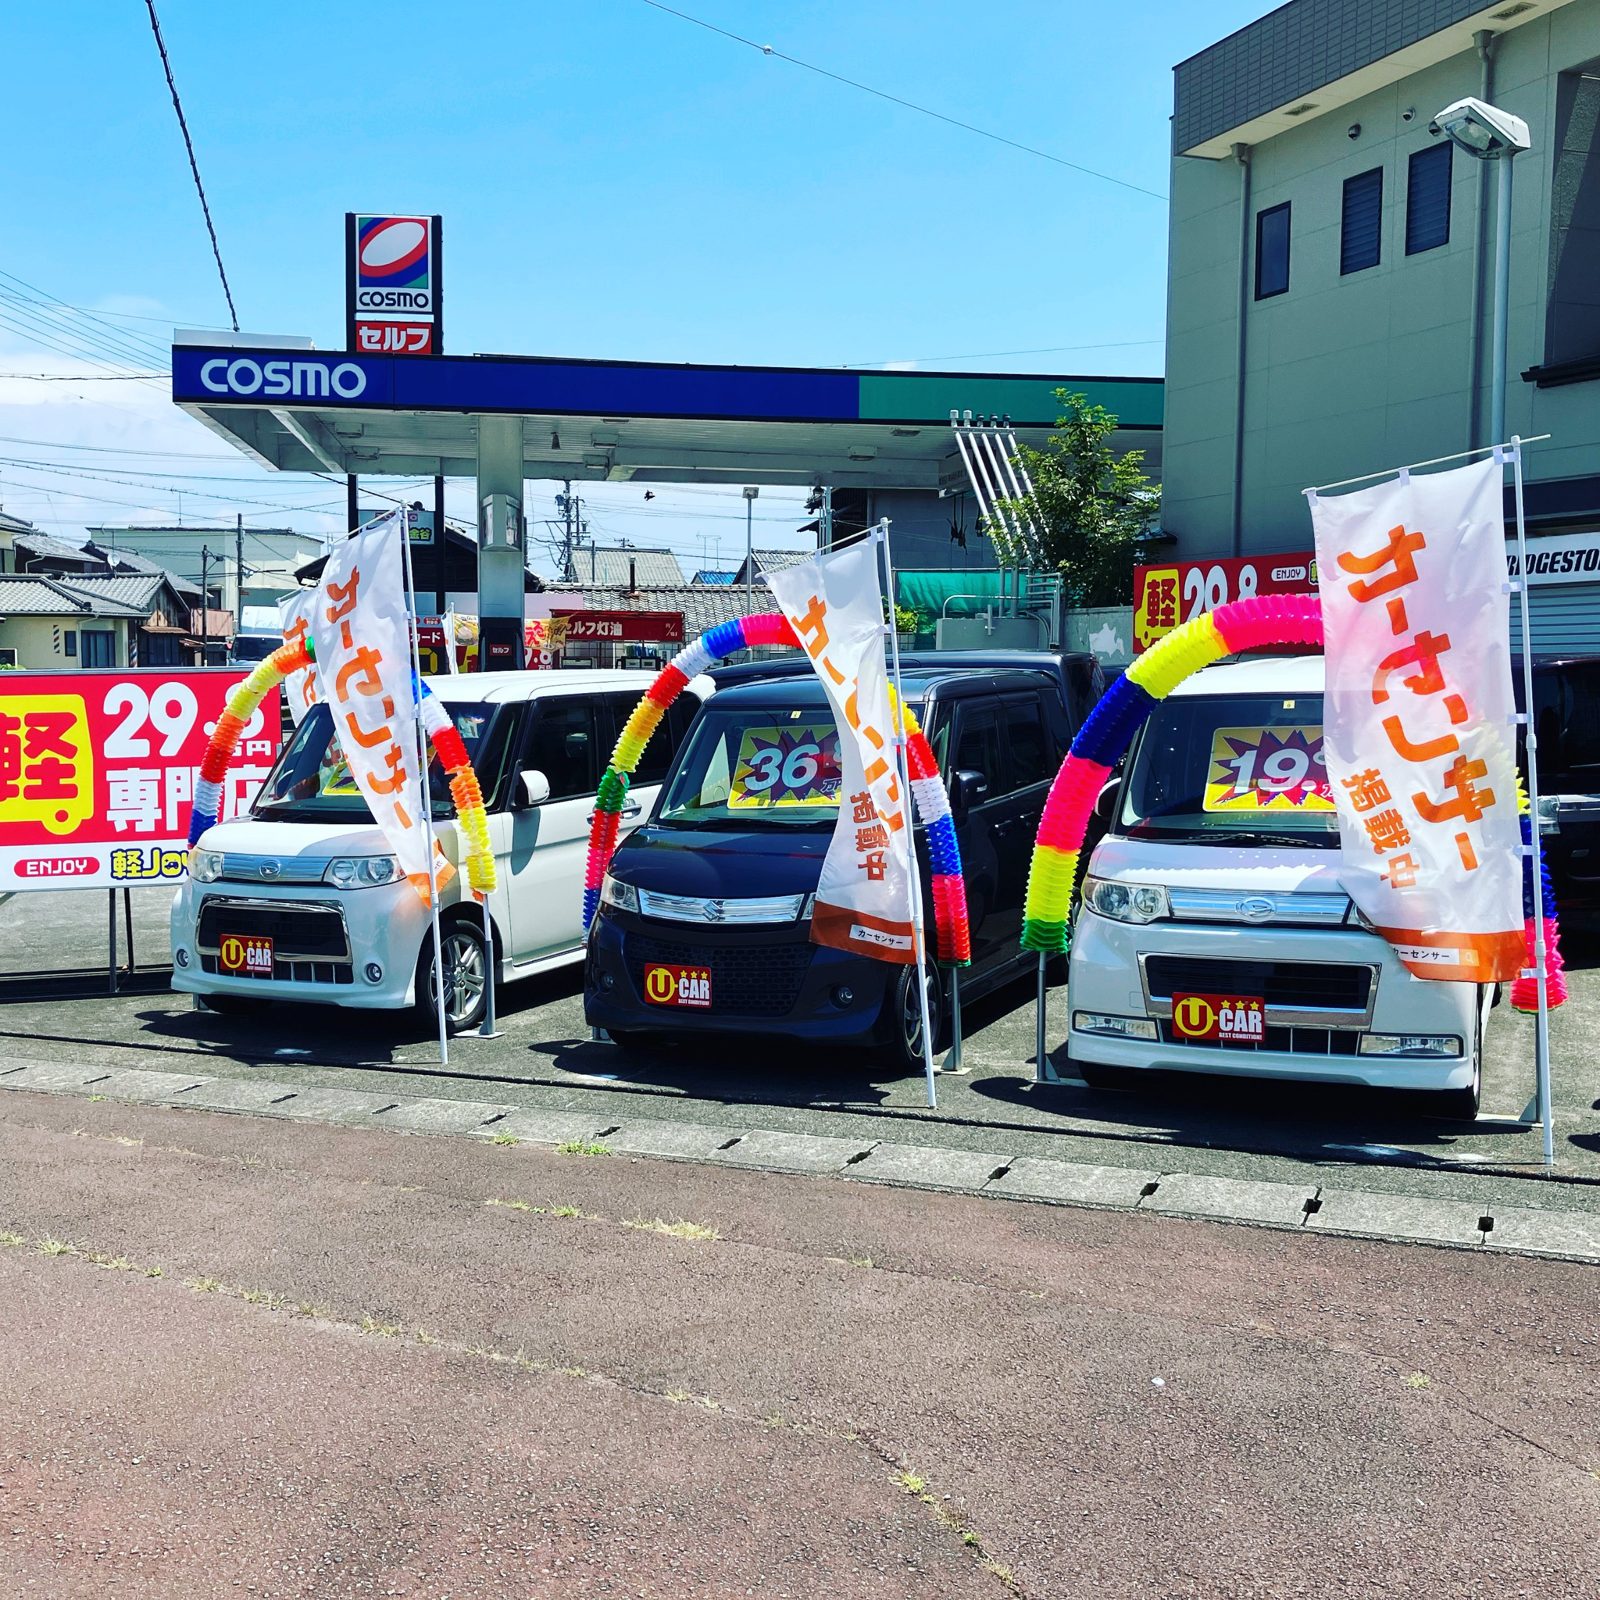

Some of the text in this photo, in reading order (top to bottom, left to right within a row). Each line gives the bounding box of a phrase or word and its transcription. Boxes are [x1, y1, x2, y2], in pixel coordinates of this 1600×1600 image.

[359, 291, 429, 308] COSMO
[359, 326, 430, 351] セルフ
[200, 358, 367, 398] COSMO
[1276, 569, 1301, 579] ENJOY
[1146, 579, 1177, 628] 軽
[326, 565, 413, 829] カーセンサー
[1337, 524, 1496, 871] カーセンサー
[0, 712, 78, 801] 軽
[1230, 746, 1326, 794] 19.
[1342, 767, 1420, 889] 掲載中
[26, 859, 88, 876] ENJOY
[858, 929, 903, 945] カーセンサー
[1393, 947, 1450, 960] カーセンサー
